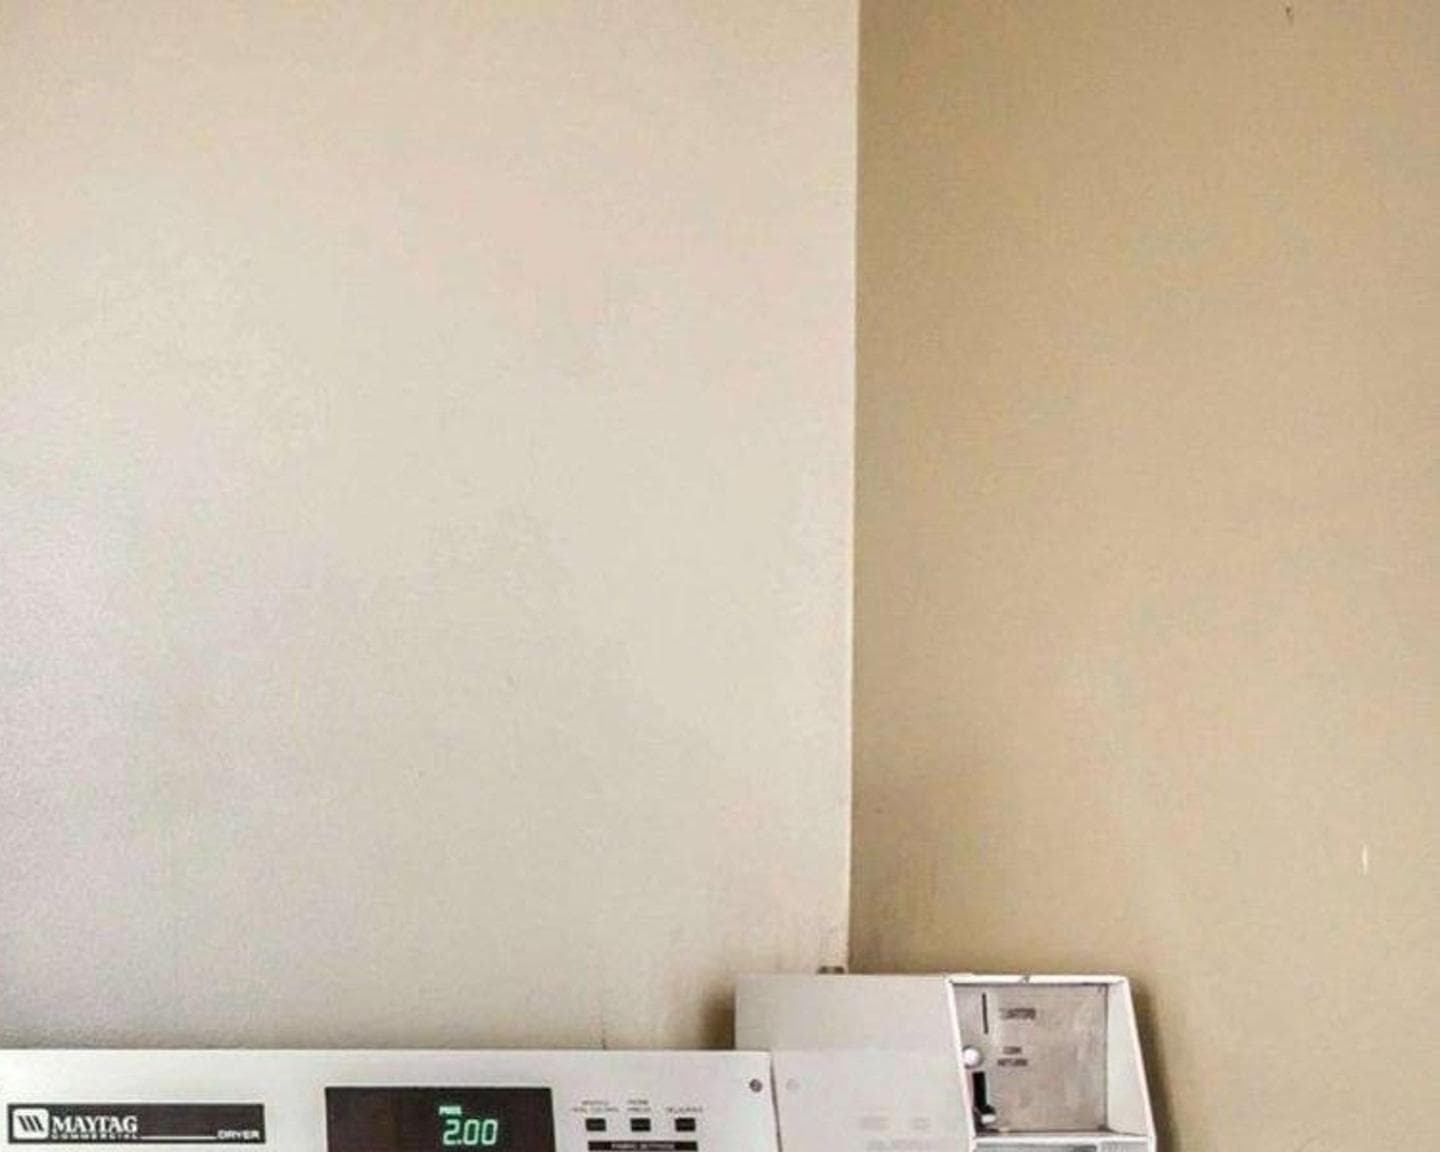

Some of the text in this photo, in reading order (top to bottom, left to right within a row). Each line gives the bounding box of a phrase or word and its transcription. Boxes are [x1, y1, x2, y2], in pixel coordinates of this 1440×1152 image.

[51, 1115, 138, 1134] MAYTAG
[443, 1118, 498, 1146] 2.00
[51, 1133, 140, 1141] COMMERCIAL
[217, 1129, 260, 1140] DRYER
